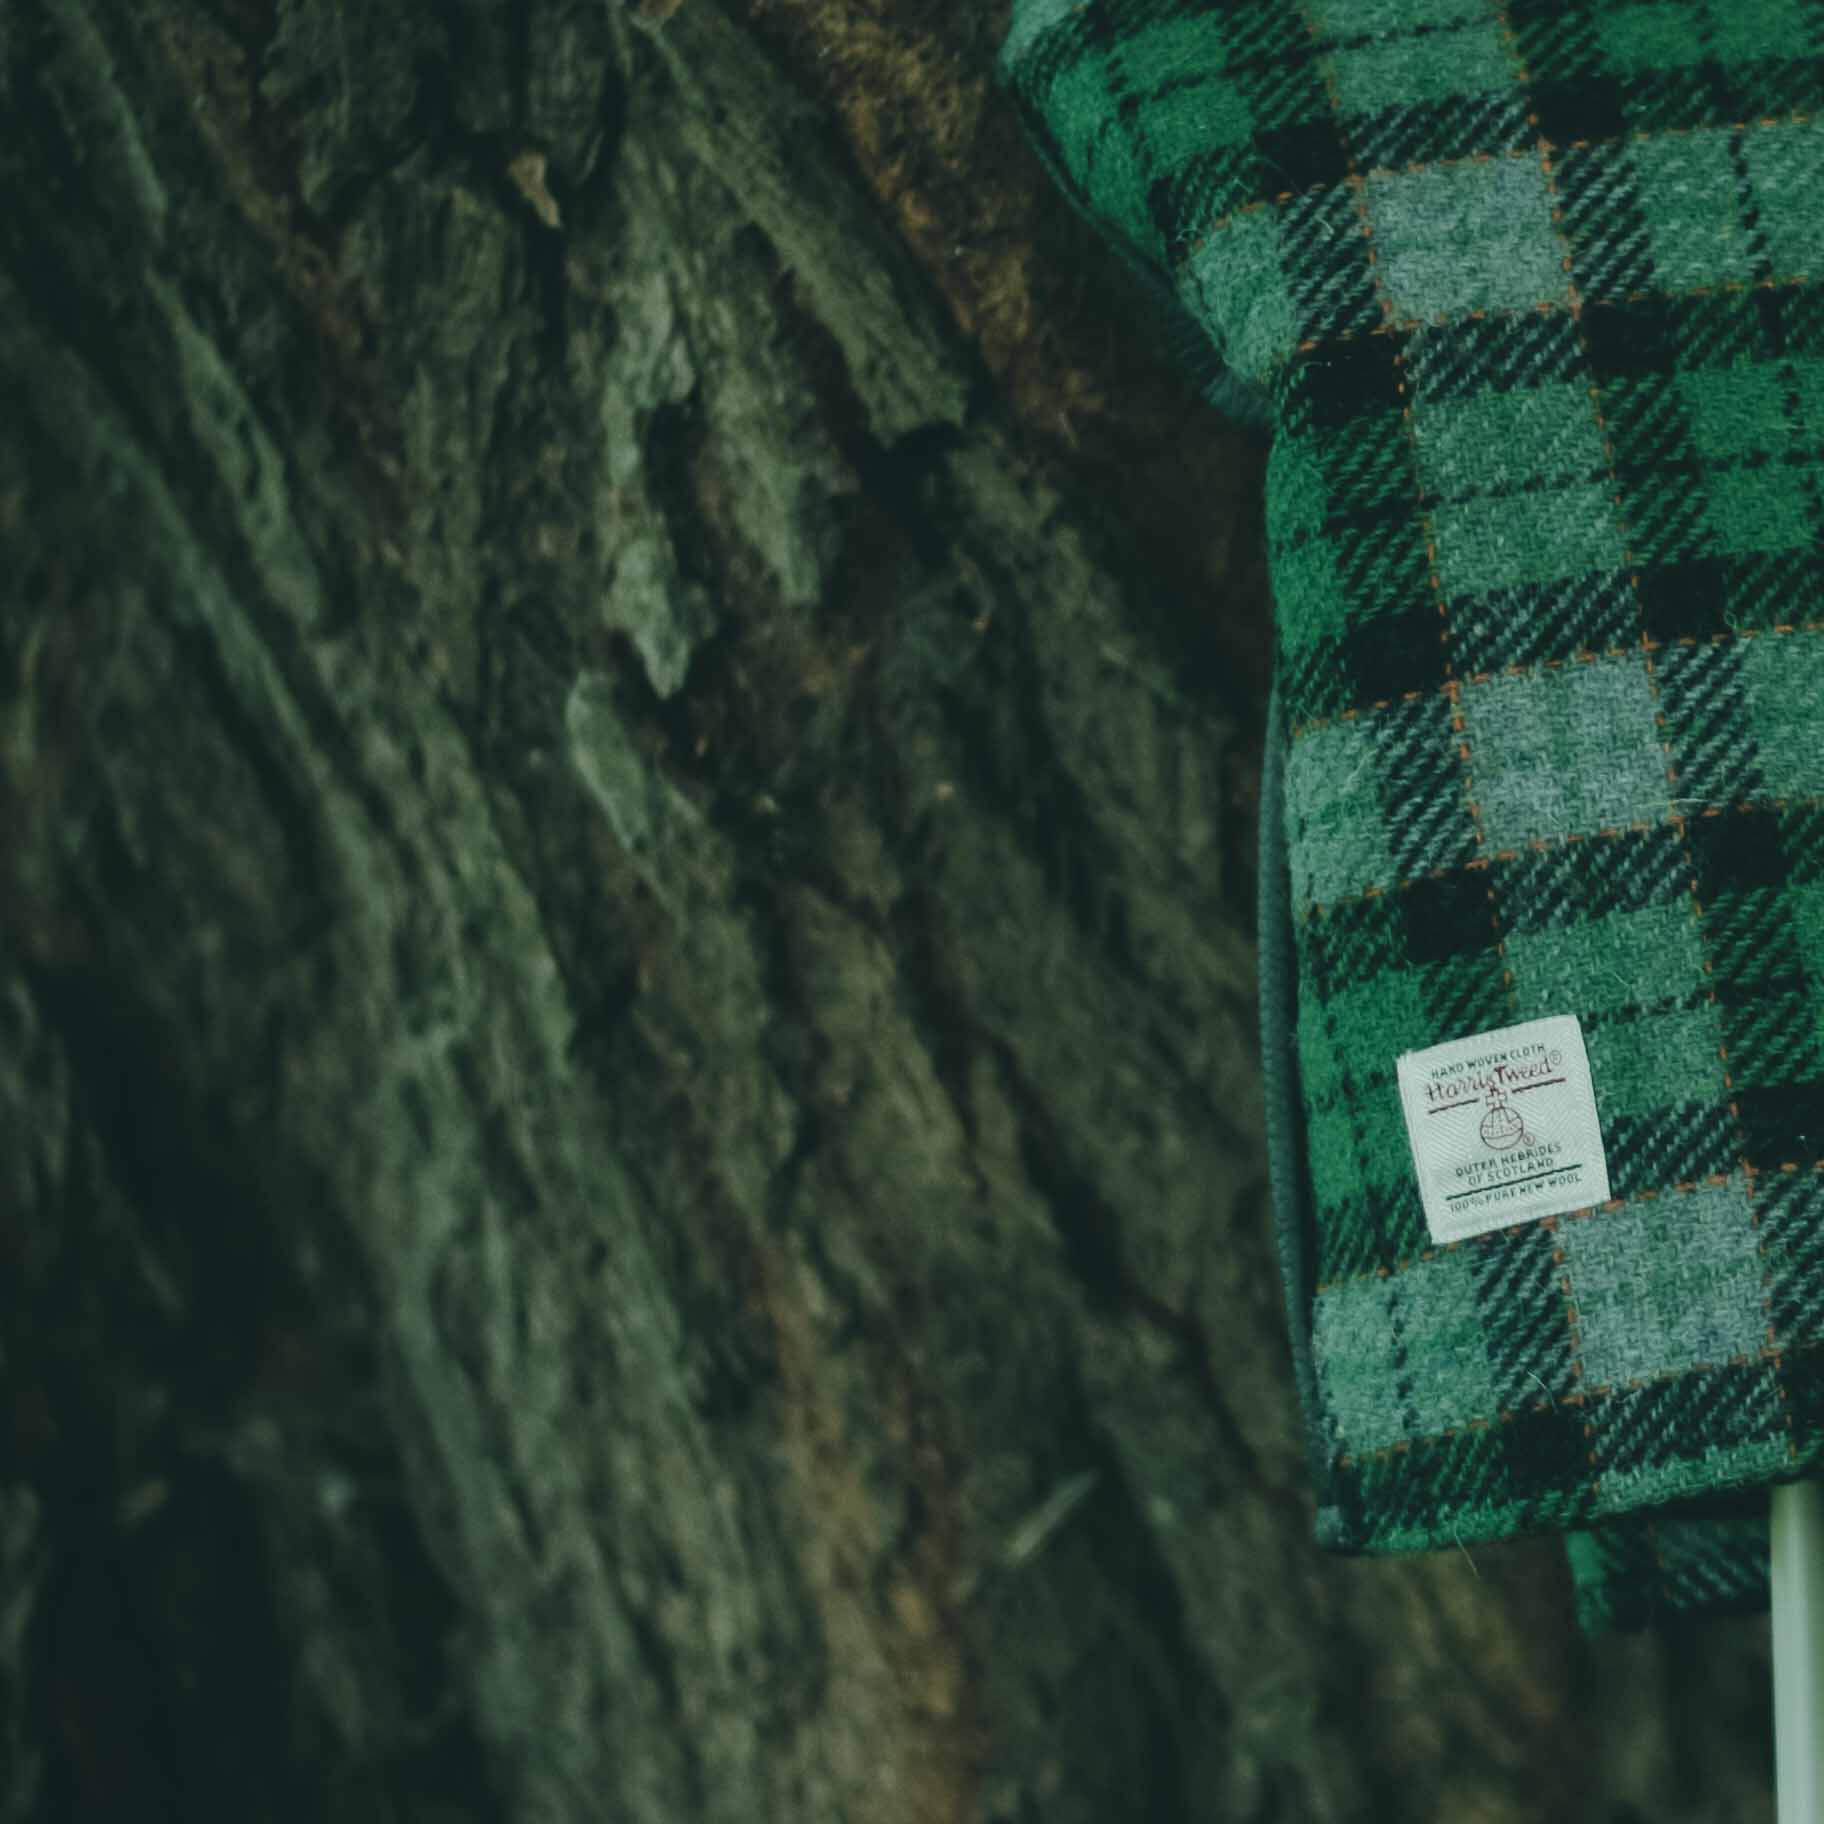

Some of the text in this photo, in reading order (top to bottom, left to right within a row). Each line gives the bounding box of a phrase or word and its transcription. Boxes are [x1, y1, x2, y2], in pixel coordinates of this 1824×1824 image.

[1425, 1056, 1552, 1101] Harris Tweed
[1431, 1043, 1546, 1079] HAND WOVEN CLOTH
[1455, 1143, 1562, 1177] OUTER HEBRIDES
[1468, 1157, 1554, 1186] OF SCOTLAND
[1450, 1172, 1582, 1213] 100% PURE NEW WOOL
